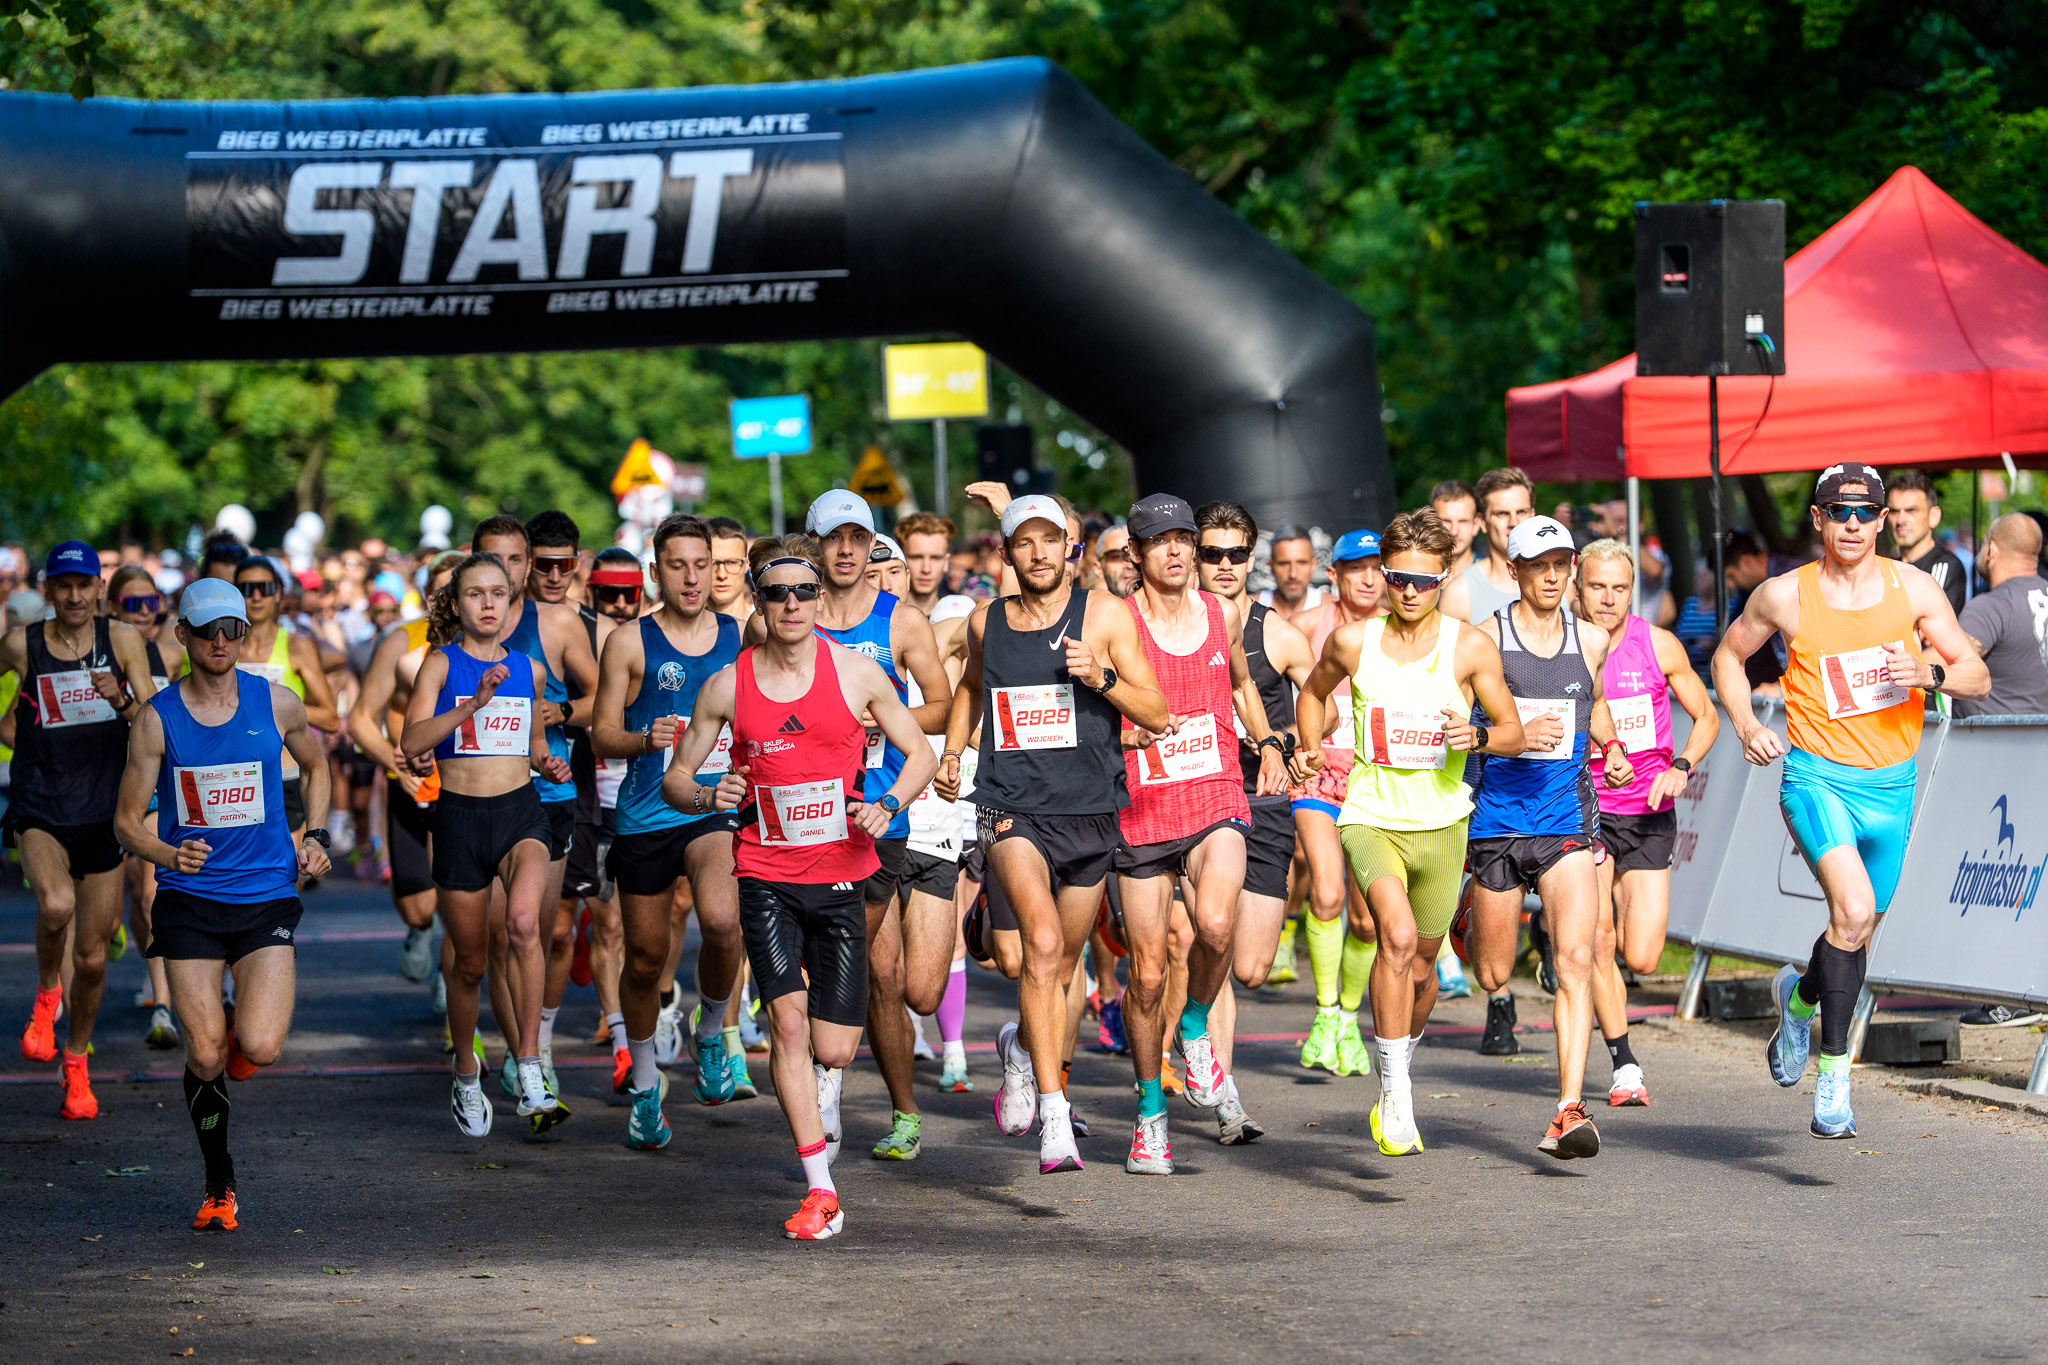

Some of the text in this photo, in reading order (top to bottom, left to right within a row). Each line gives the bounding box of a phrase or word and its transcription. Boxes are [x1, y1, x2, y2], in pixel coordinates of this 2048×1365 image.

[541, 113, 810, 145] BIEG WESTERPLATTE
[217, 127, 488, 150] BIEG WESTERPLATTE
[271, 148, 755, 286] START
[546, 281, 819, 314] BIEG WESTERPLATTE
[219, 295, 494, 320] BIEG WESTERPLATTE
[1852, 667, 1890, 688] 382
[484, 716, 521, 731] 1476
[1016, 708, 1071, 726] 2929
[1613, 714, 1647, 732] 459
[763, 738, 784, 748] SKLEP
[1027, 735, 1064, 743] WOJCIECH
[1163, 734, 1213, 758] 3429
[1390, 729, 1446, 747] 3868
[764, 742, 796, 754] BIEGACZA
[207, 786, 255, 805] 3180
[220, 813, 247, 821] PATRYK
[785, 800, 834, 821] 1660
[800, 828, 826, 837] DANIEL
